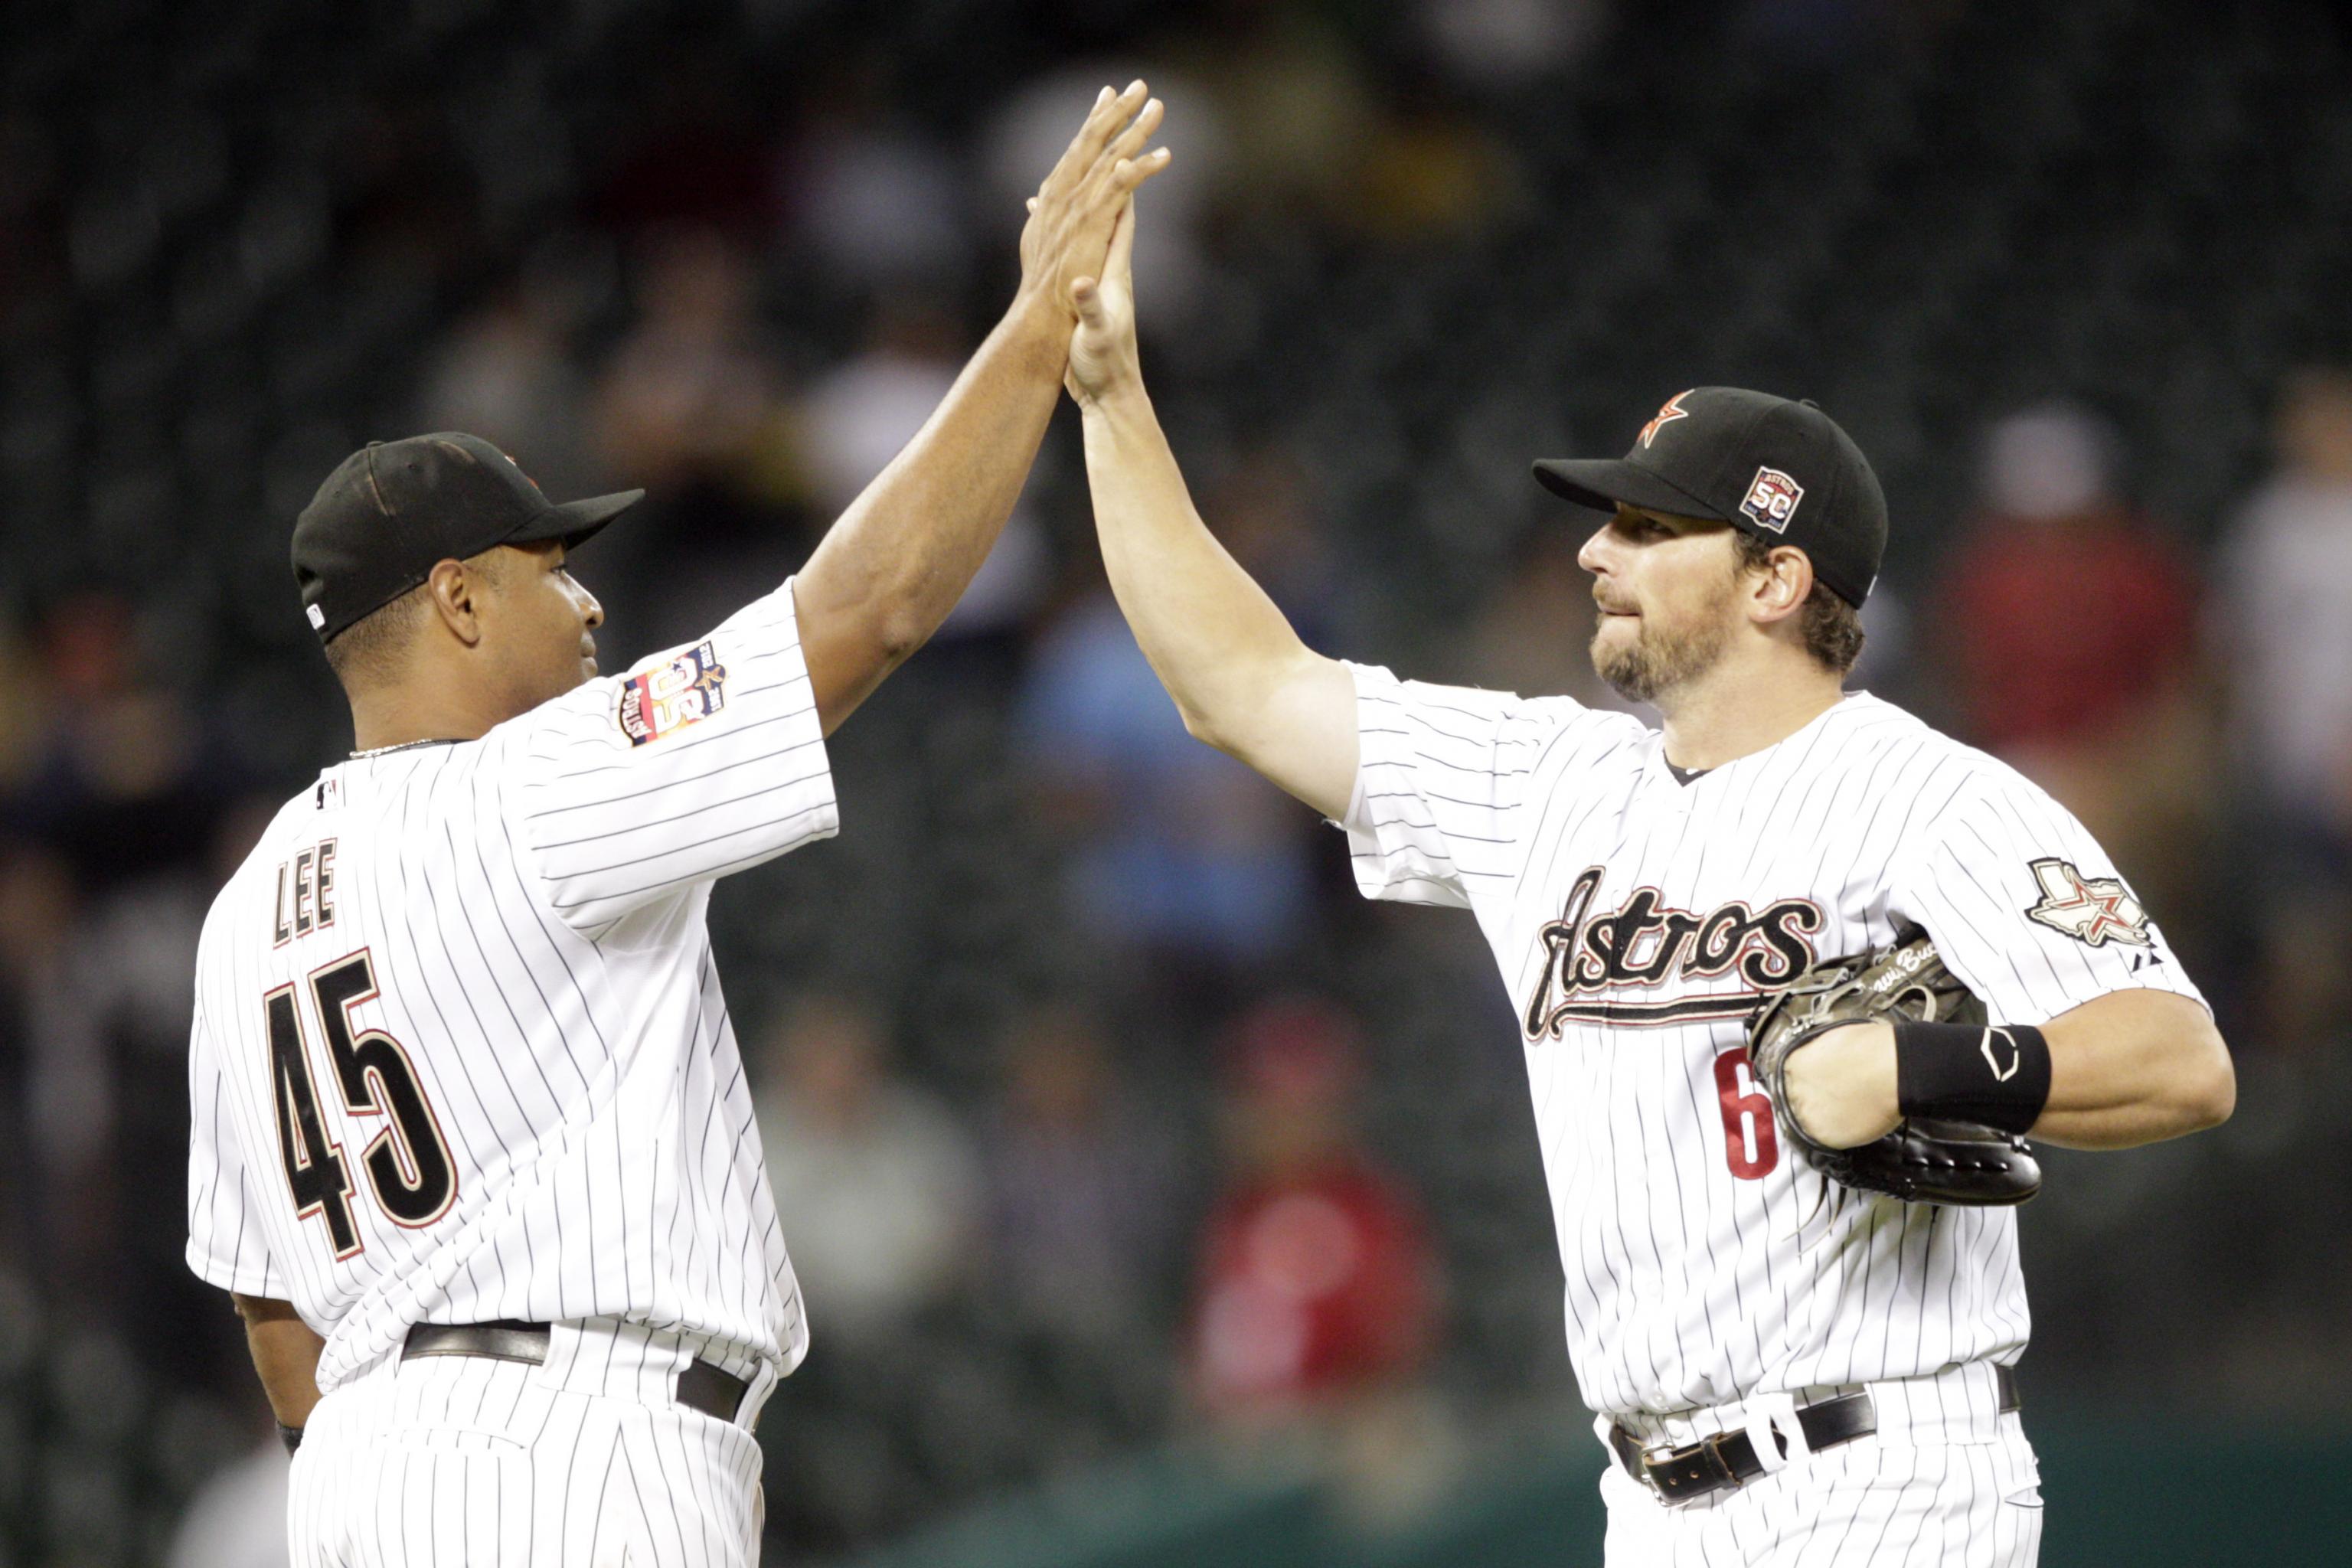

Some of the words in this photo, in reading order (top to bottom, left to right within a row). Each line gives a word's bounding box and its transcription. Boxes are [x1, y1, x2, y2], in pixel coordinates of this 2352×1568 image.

[1752, 482, 1791, 519] 50
[1764, 473, 1795, 495] ASTROS
[622, 687, 652, 738] ASTROS
[648, 656, 706, 733] 50
[273, 837, 338, 949] LEE
[1523, 865, 1827, 1042] Astros
[1896, 942, 1937, 972] Buc
[263, 946, 459, 1263] 45
[1714, 1047, 1779, 1181] 6
